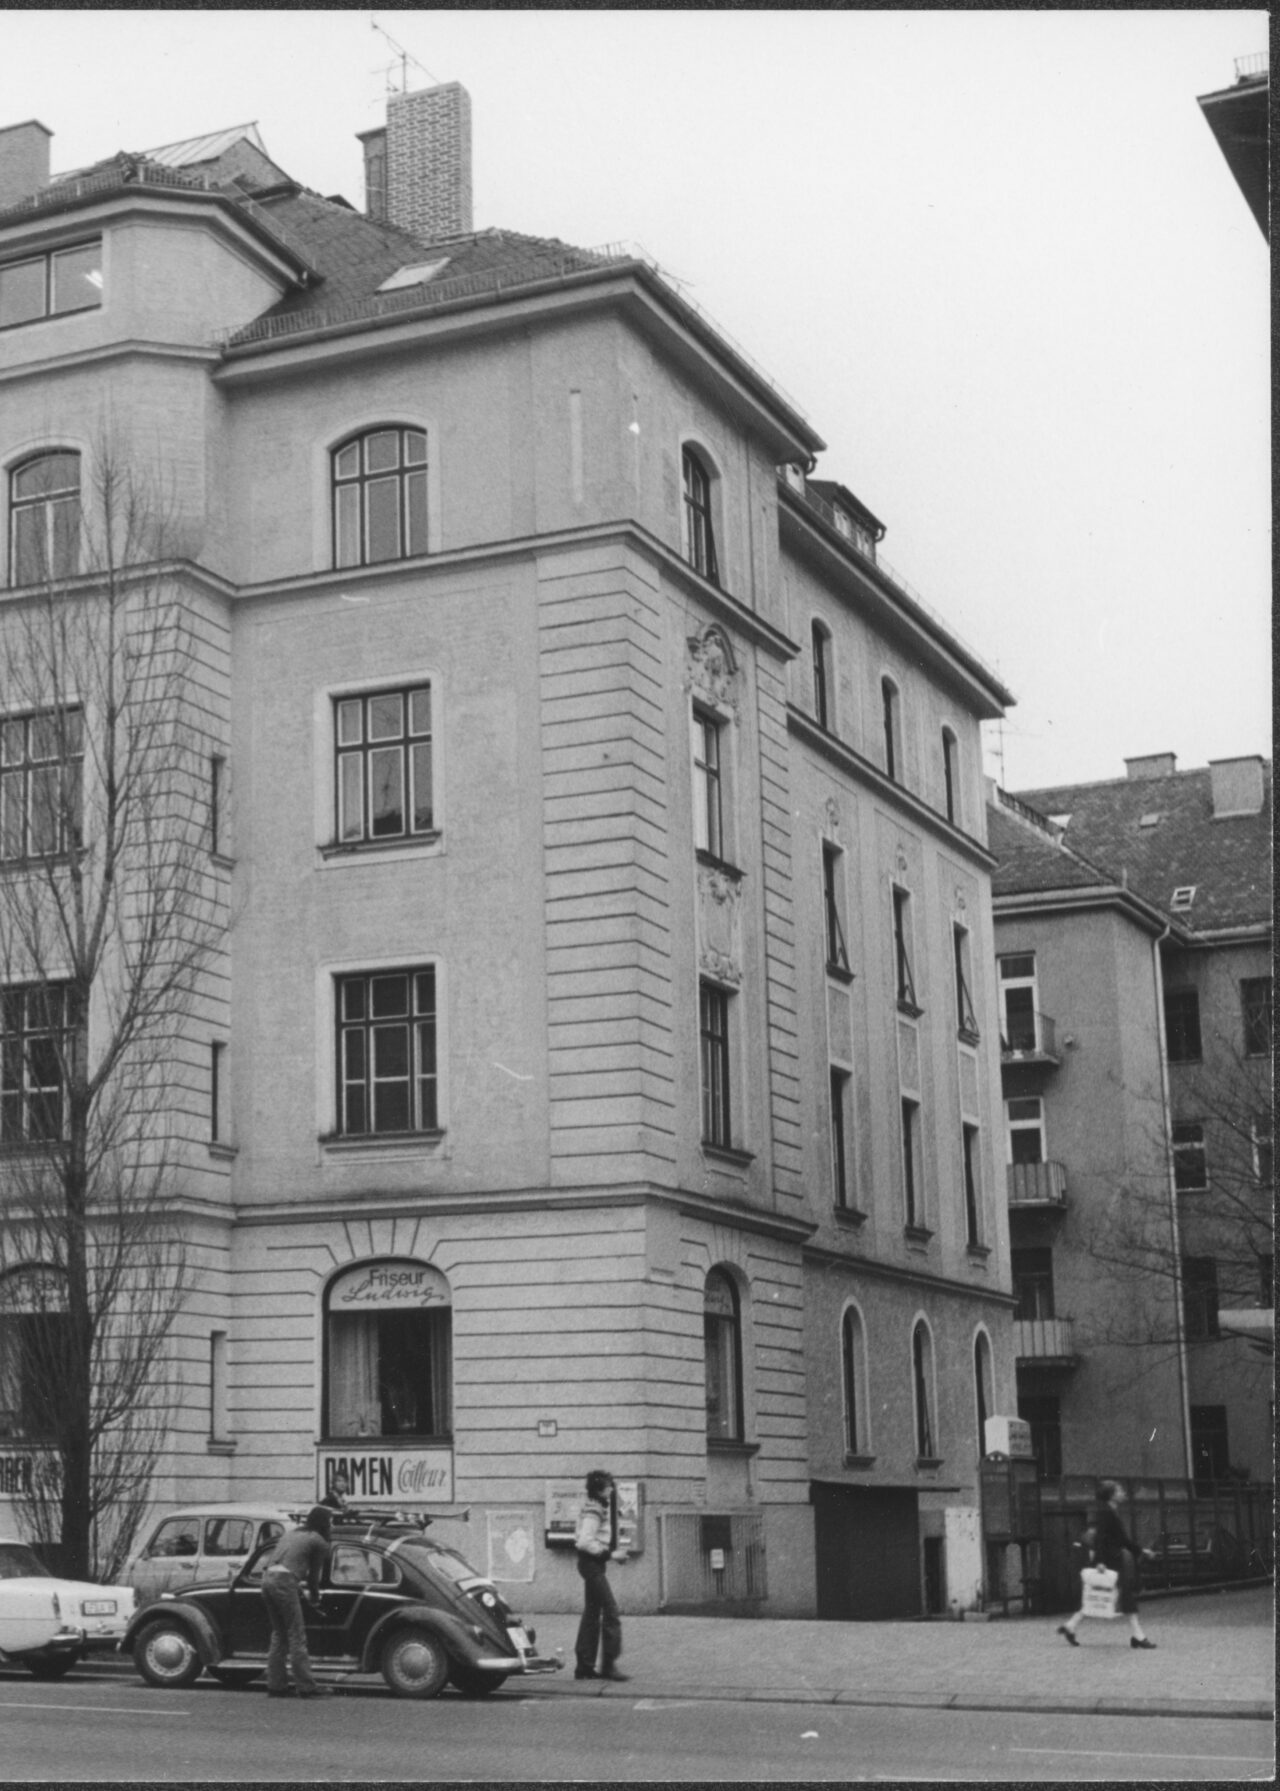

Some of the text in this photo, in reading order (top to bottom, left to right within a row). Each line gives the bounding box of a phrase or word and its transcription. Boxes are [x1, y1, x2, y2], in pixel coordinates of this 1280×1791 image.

[369, 1269, 425, 1287] Friseur
[341, 1280, 445, 1306] Ludwig
[324, 1457, 447, 1496] DAMEN Coiffeur
